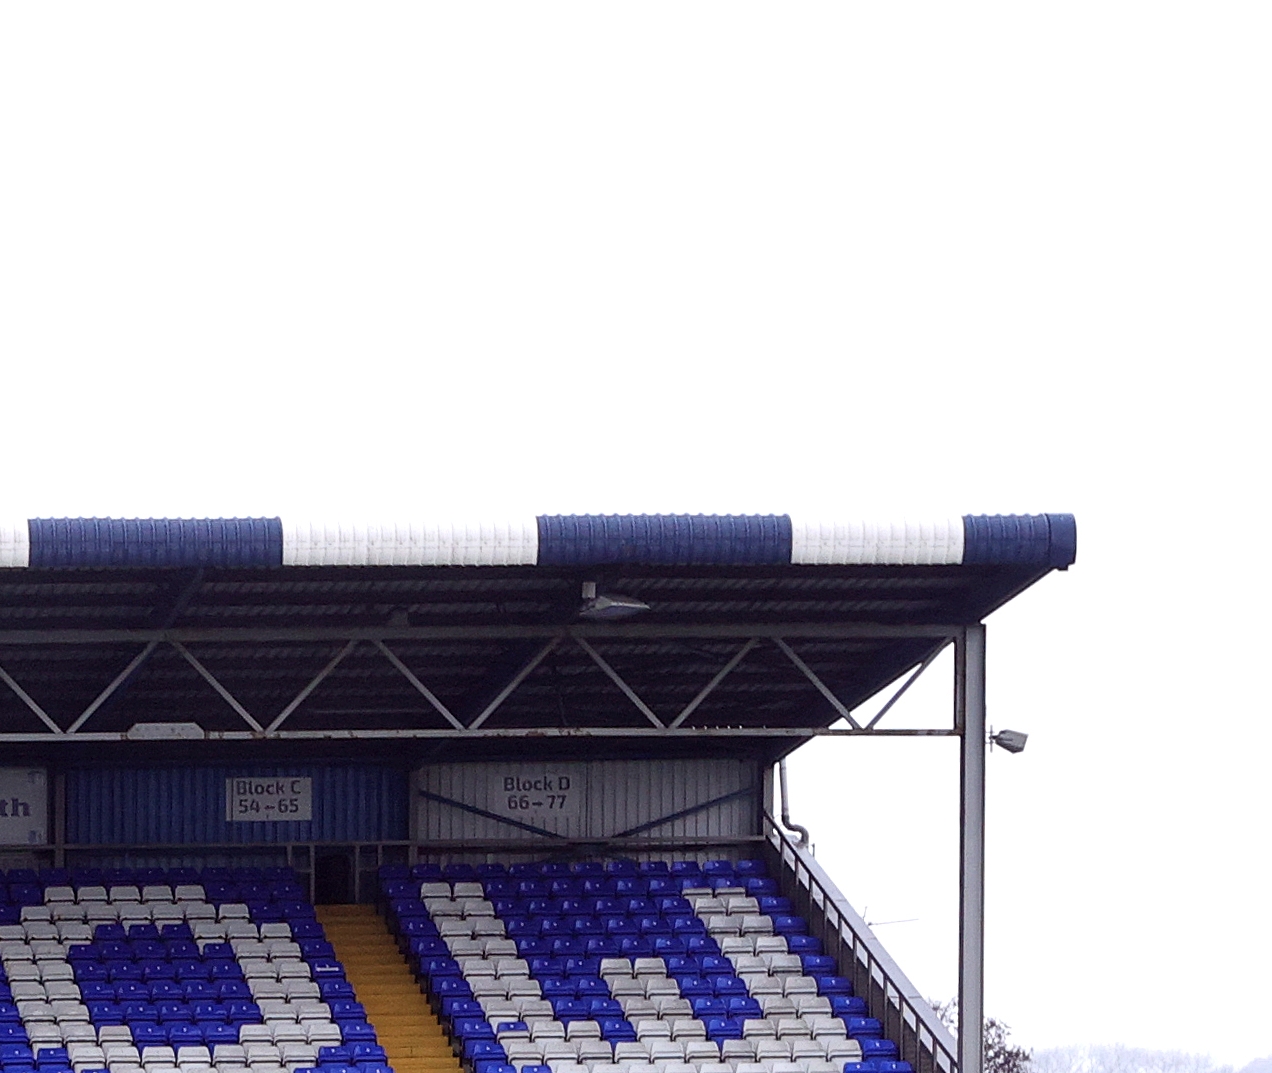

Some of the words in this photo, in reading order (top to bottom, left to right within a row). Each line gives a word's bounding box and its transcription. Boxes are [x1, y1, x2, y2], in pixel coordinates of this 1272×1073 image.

[236, 780, 285, 795] Block
[291, 780, 302, 794] C
[503, 776, 553, 792] Block
[558, 776, 571, 791] D
